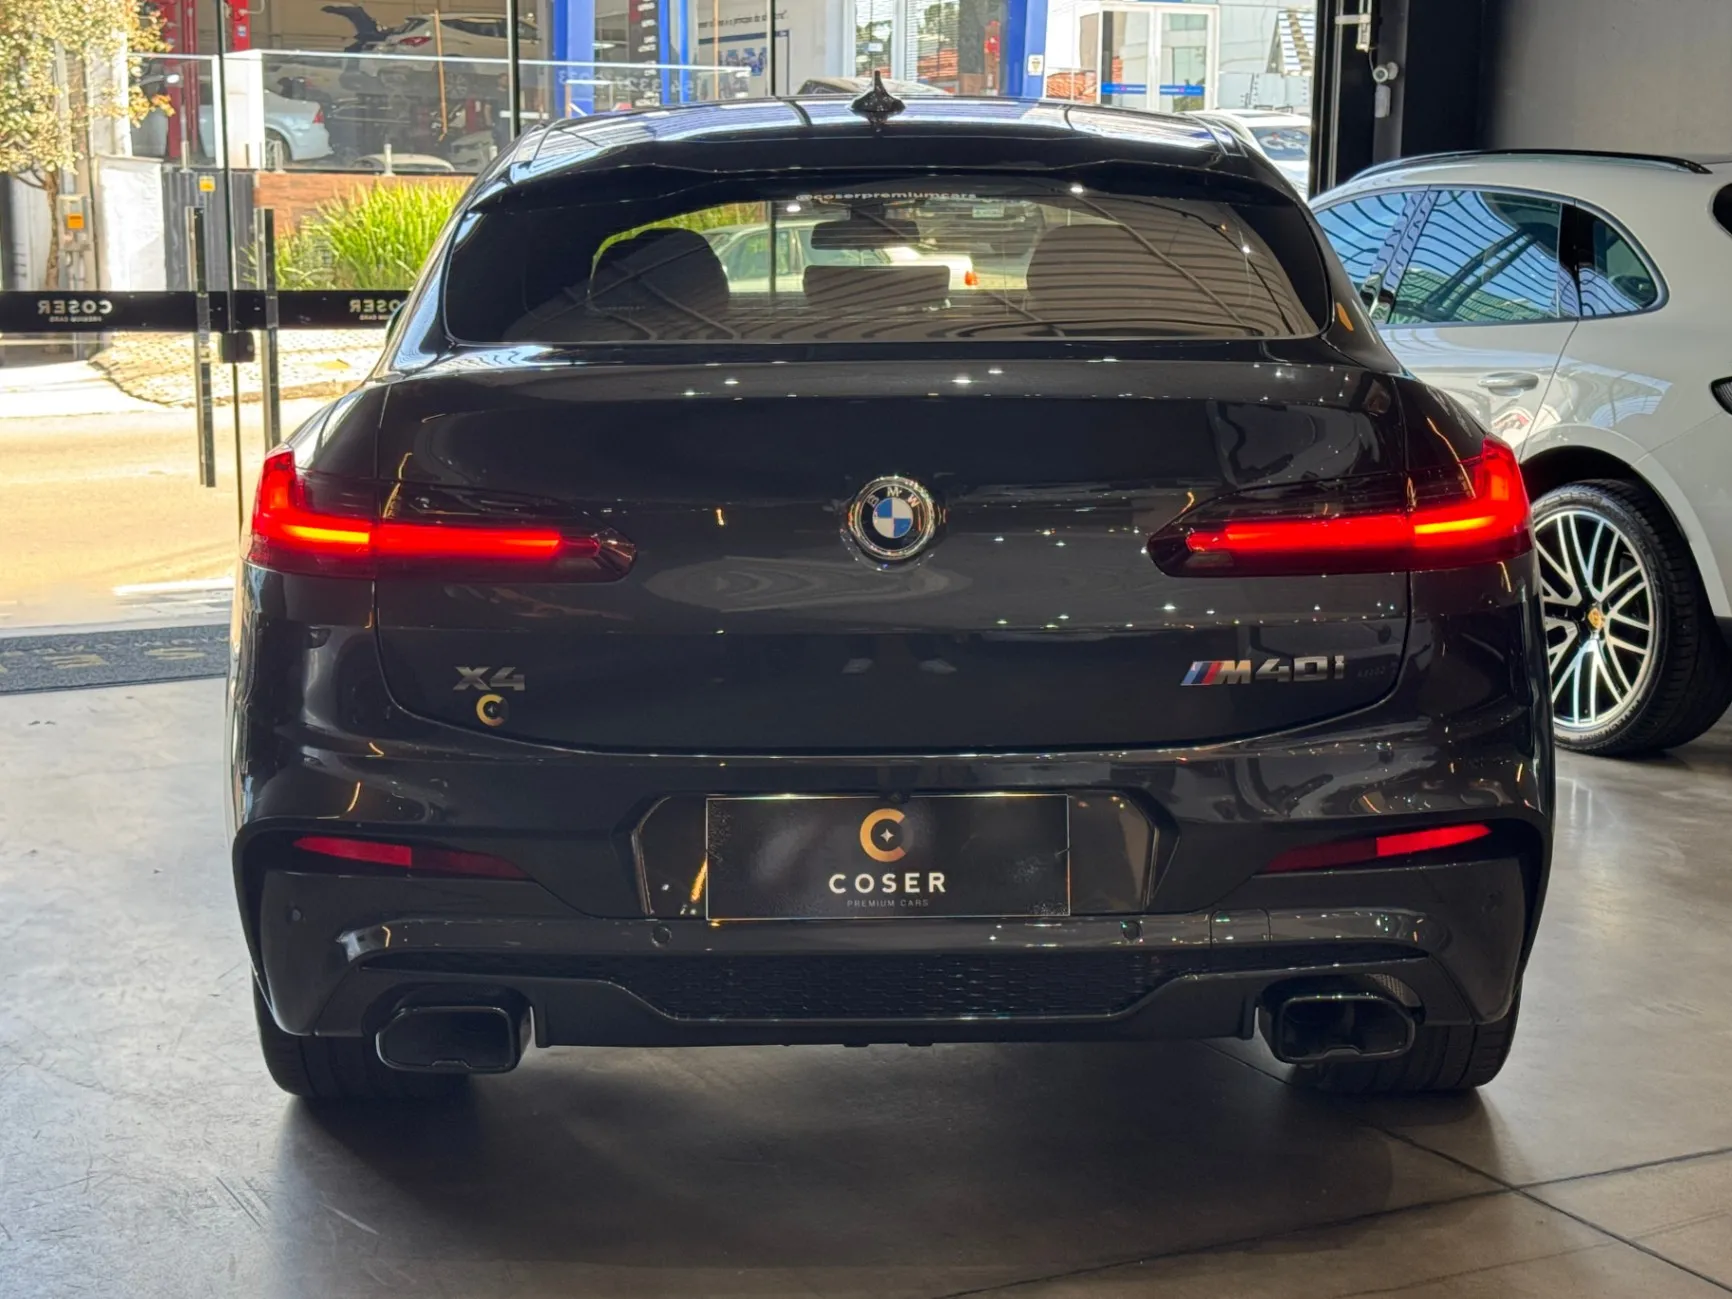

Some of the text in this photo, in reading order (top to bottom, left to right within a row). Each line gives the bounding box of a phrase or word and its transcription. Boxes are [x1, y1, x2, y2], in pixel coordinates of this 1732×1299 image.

[865, 486, 921, 508] BMW
[452, 665, 526, 691] X4
[828, 872, 946, 894] COSER
[846, 898, 929, 908] PREMIUM CARS
